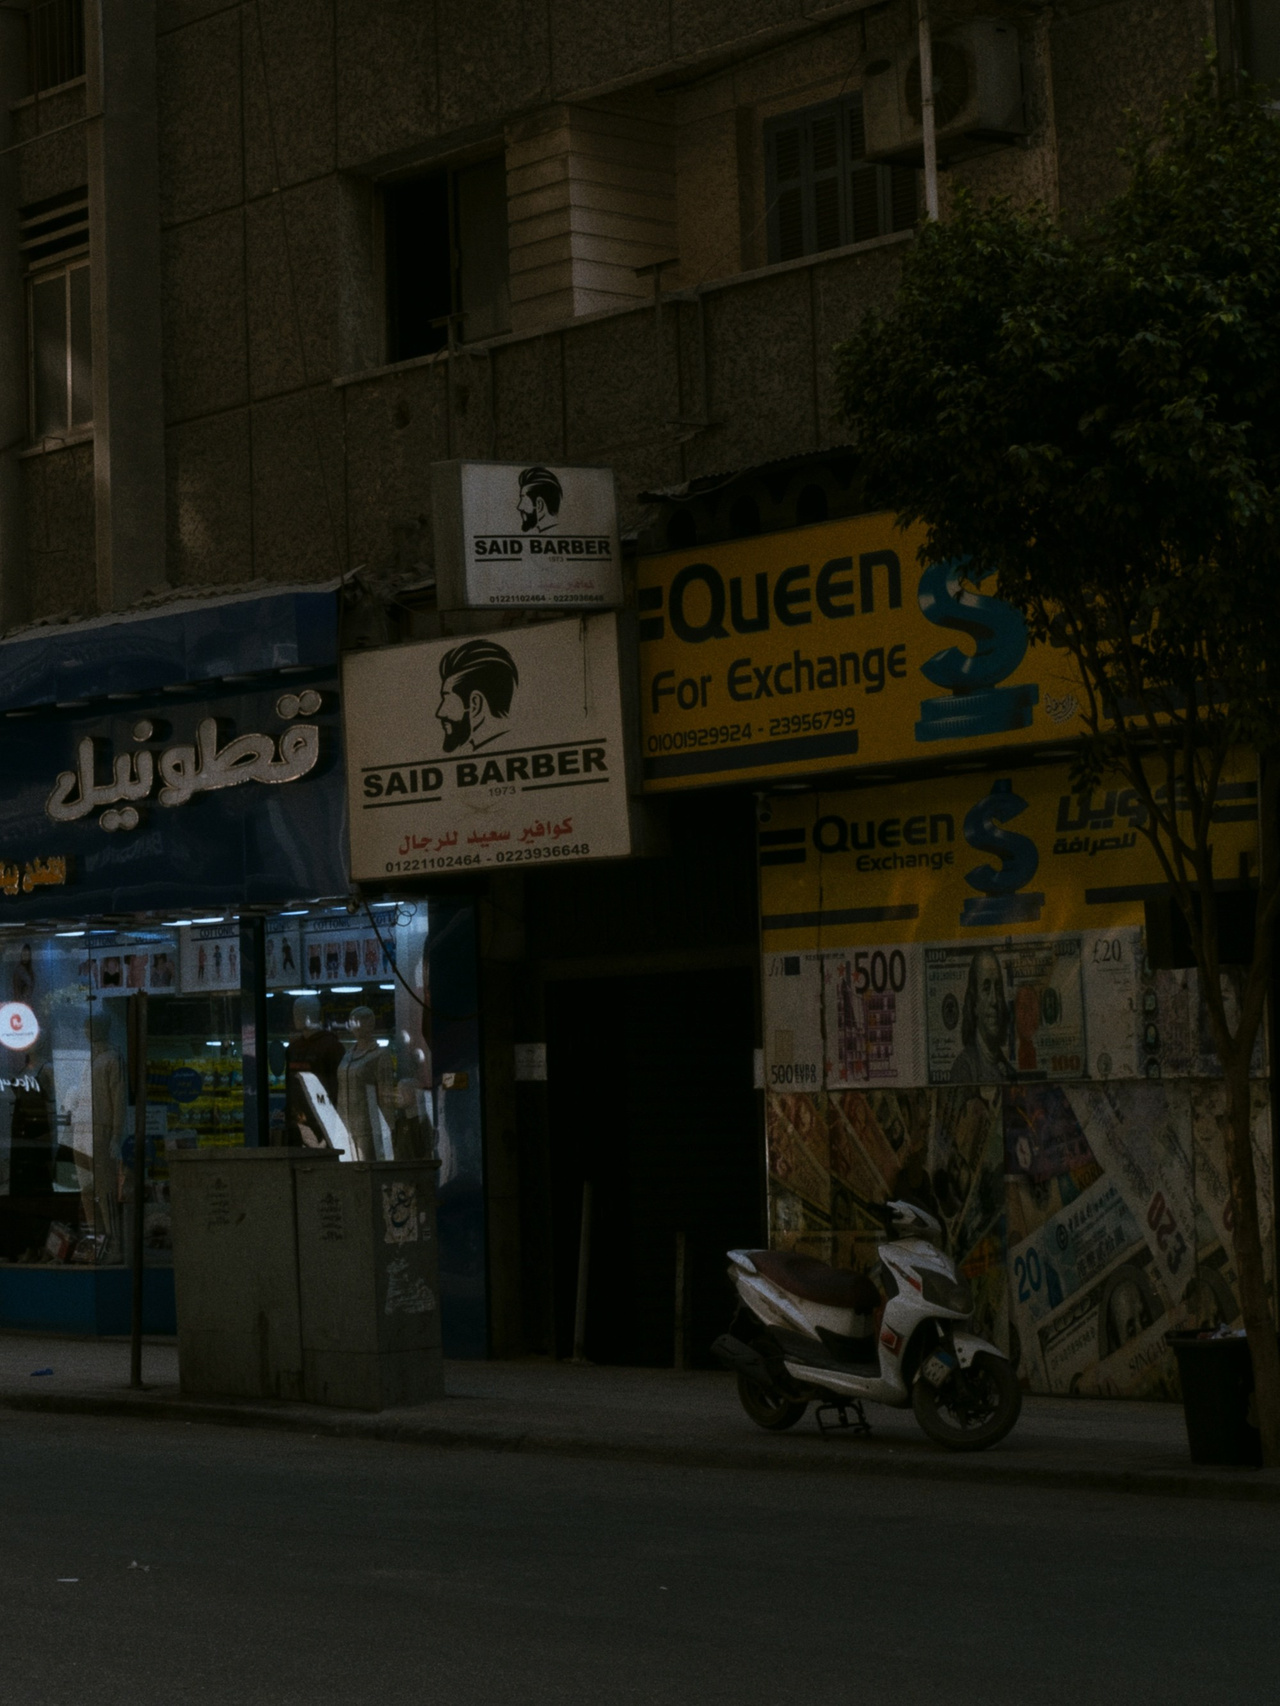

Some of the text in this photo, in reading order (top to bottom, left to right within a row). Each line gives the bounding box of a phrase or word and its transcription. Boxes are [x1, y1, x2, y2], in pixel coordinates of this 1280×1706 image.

[474, 538, 611, 556] SAID BARBER
[651, 643, 908, 714] For Exchange
[647, 721, 753, 753] 01001929924
[769, 708, 855, 736] 23956799
[44, 689, 323, 833] قطونيل
[363, 745, 609, 799] SAID BARBER
[488, 785, 517, 798] 1973
[399, 816, 574, 856] كوافير سعيد للرجال
[1053, 832, 1137, 856] للصرافة
[385, 854, 482, 873] 01221102464
[496, 843, 590, 864] 0223936648
[855, 850, 955, 873] Exchange
[1092, 938, 1122, 963] £20
[854, 949, 907, 994] 500
[771, 1064, 794, 1085] 500
[1014, 1246, 1042, 1303] 20
